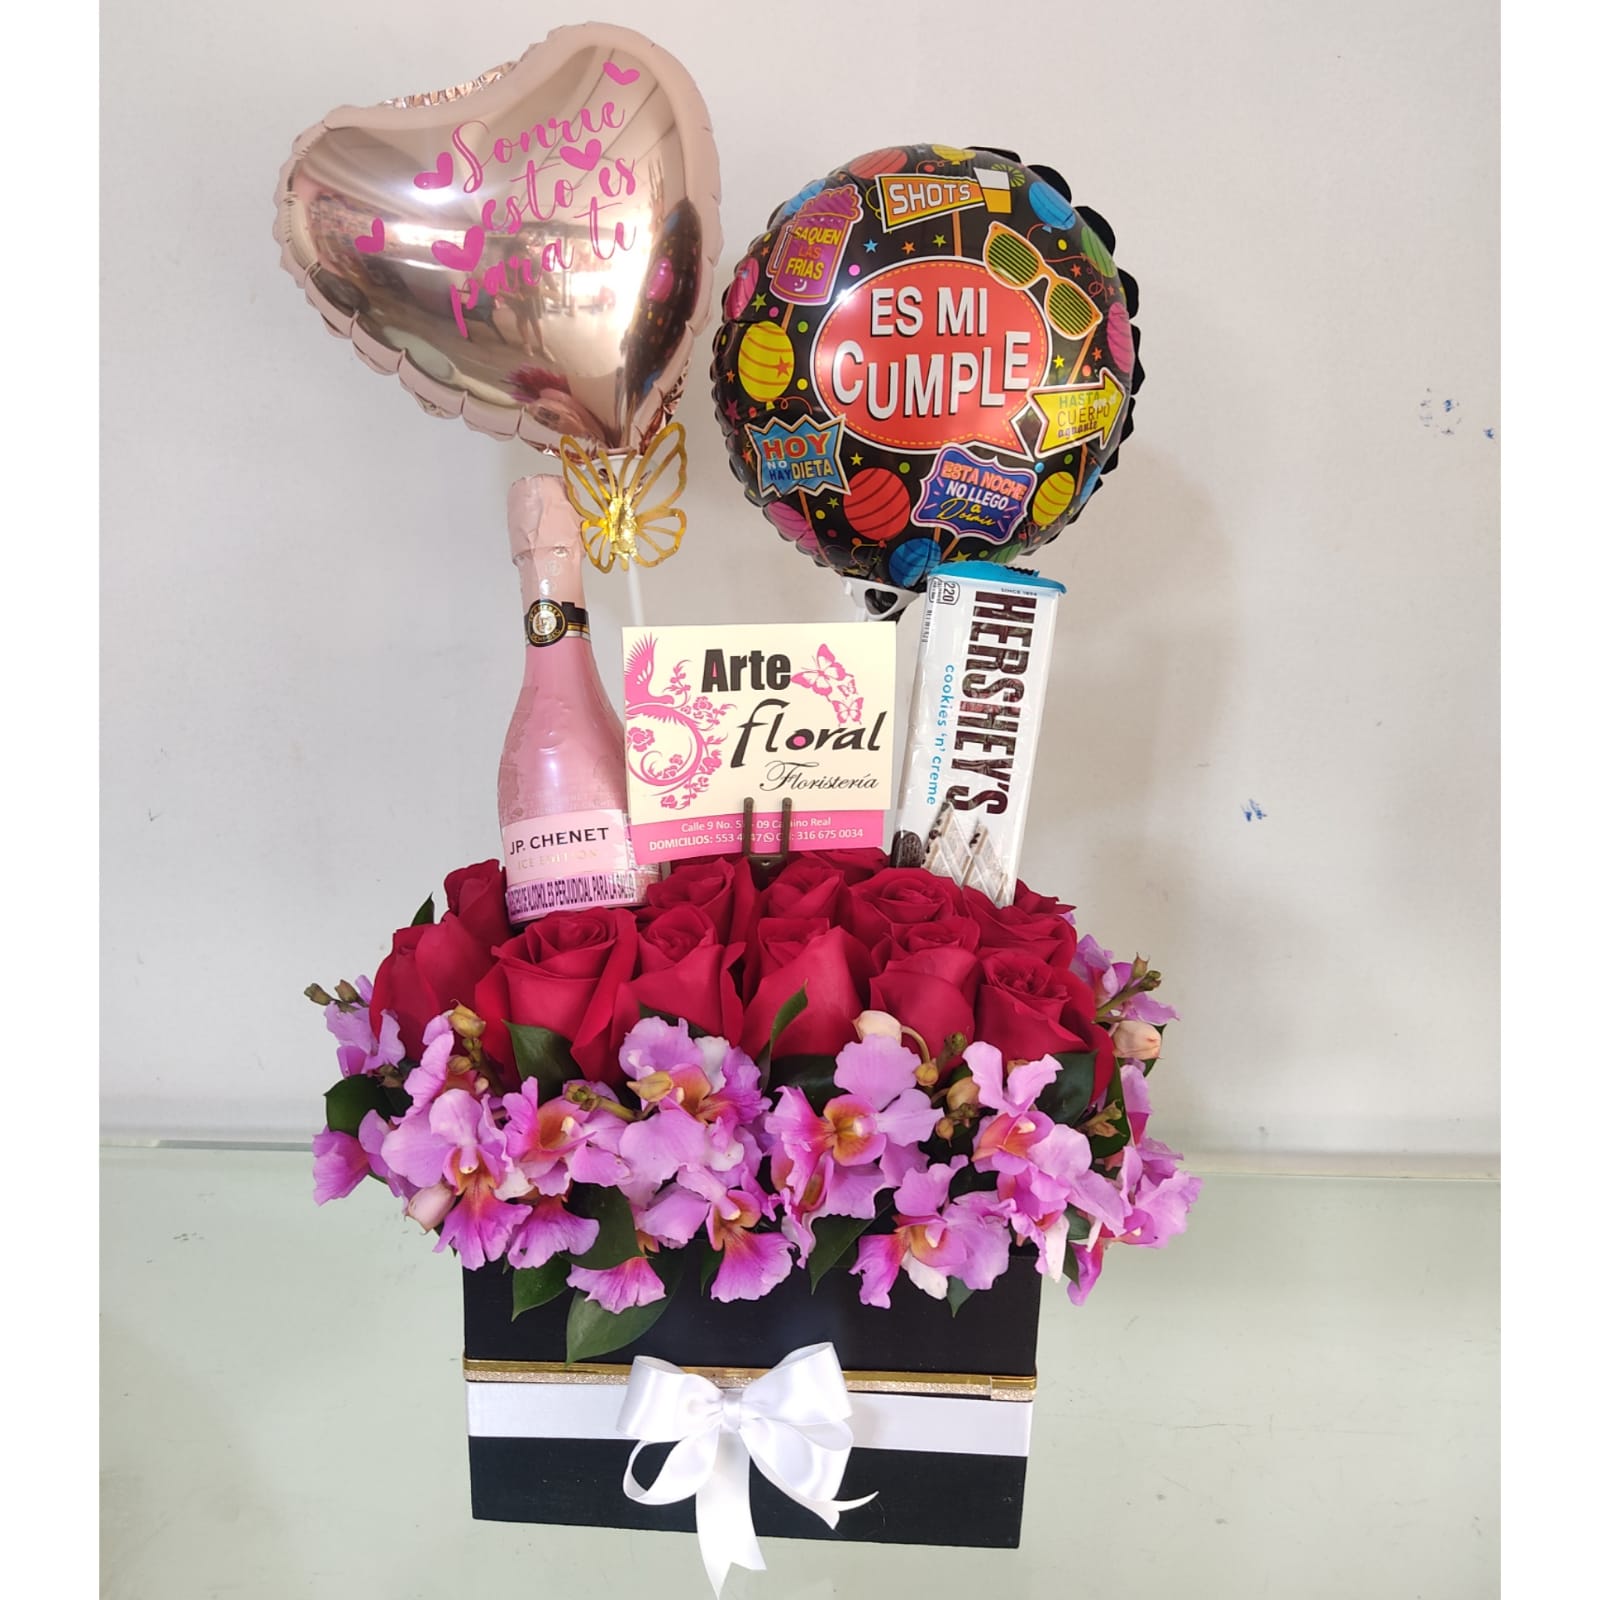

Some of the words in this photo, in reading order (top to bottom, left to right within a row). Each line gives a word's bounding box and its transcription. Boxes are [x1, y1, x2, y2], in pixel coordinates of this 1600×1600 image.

[482, 160, 582, 234] esto
[599, 158, 636, 197] es
[889, 183, 971, 215] SHOTS
[794, 226, 842, 246] SAQUEN
[798, 244, 822, 260] LAS
[785, 257, 825, 281] FRIAS
[450, 238, 575, 339] para
[870, 286, 924, 338] ES
[936, 286, 988, 337] MI
[831, 331, 1031, 421] CUMPLE
[1057, 401, 1112, 428] CUERPO
[1059, 391, 1100, 409] HASTA
[762, 431, 832, 461] HOY
[767, 460, 788, 470] NO
[769, 469, 791, 480] HAY
[791, 458, 834, 480] DIETA
[940, 460, 980, 486] ESTA
[980, 471, 1028, 501] NOCHE
[945, 480, 968, 499] NO
[967, 487, 1009, 511] LLEGO
[970, 504, 982, 514] a
[942, 582, 957, 602] 220
[701, 648, 791, 693] Arte
[937, 664, 955, 727] cookies
[945, 591, 1037, 814] HERSHEY'S
[730, 698, 888, 768] floral
[759, 760, 879, 791] Floristería
[926, 755, 942, 806] creme
[649, 834, 713, 851] DOMICILIOS:
[715, 833, 734, 843] 553
[796, 830, 816, 840] 316
[818, 829, 837, 839] 675
[838, 828, 864, 838] 0034
[681, 821, 705, 833] Calle
[707, 821, 714, 830] 9
[716, 820, 733, 830] No.
[756, 819, 769, 829] 09
[771, 818, 808, 829] Caino
[811, 816, 832, 826] Real
[510, 839, 526, 855] JP.
[530, 827, 609, 849] CHENET
